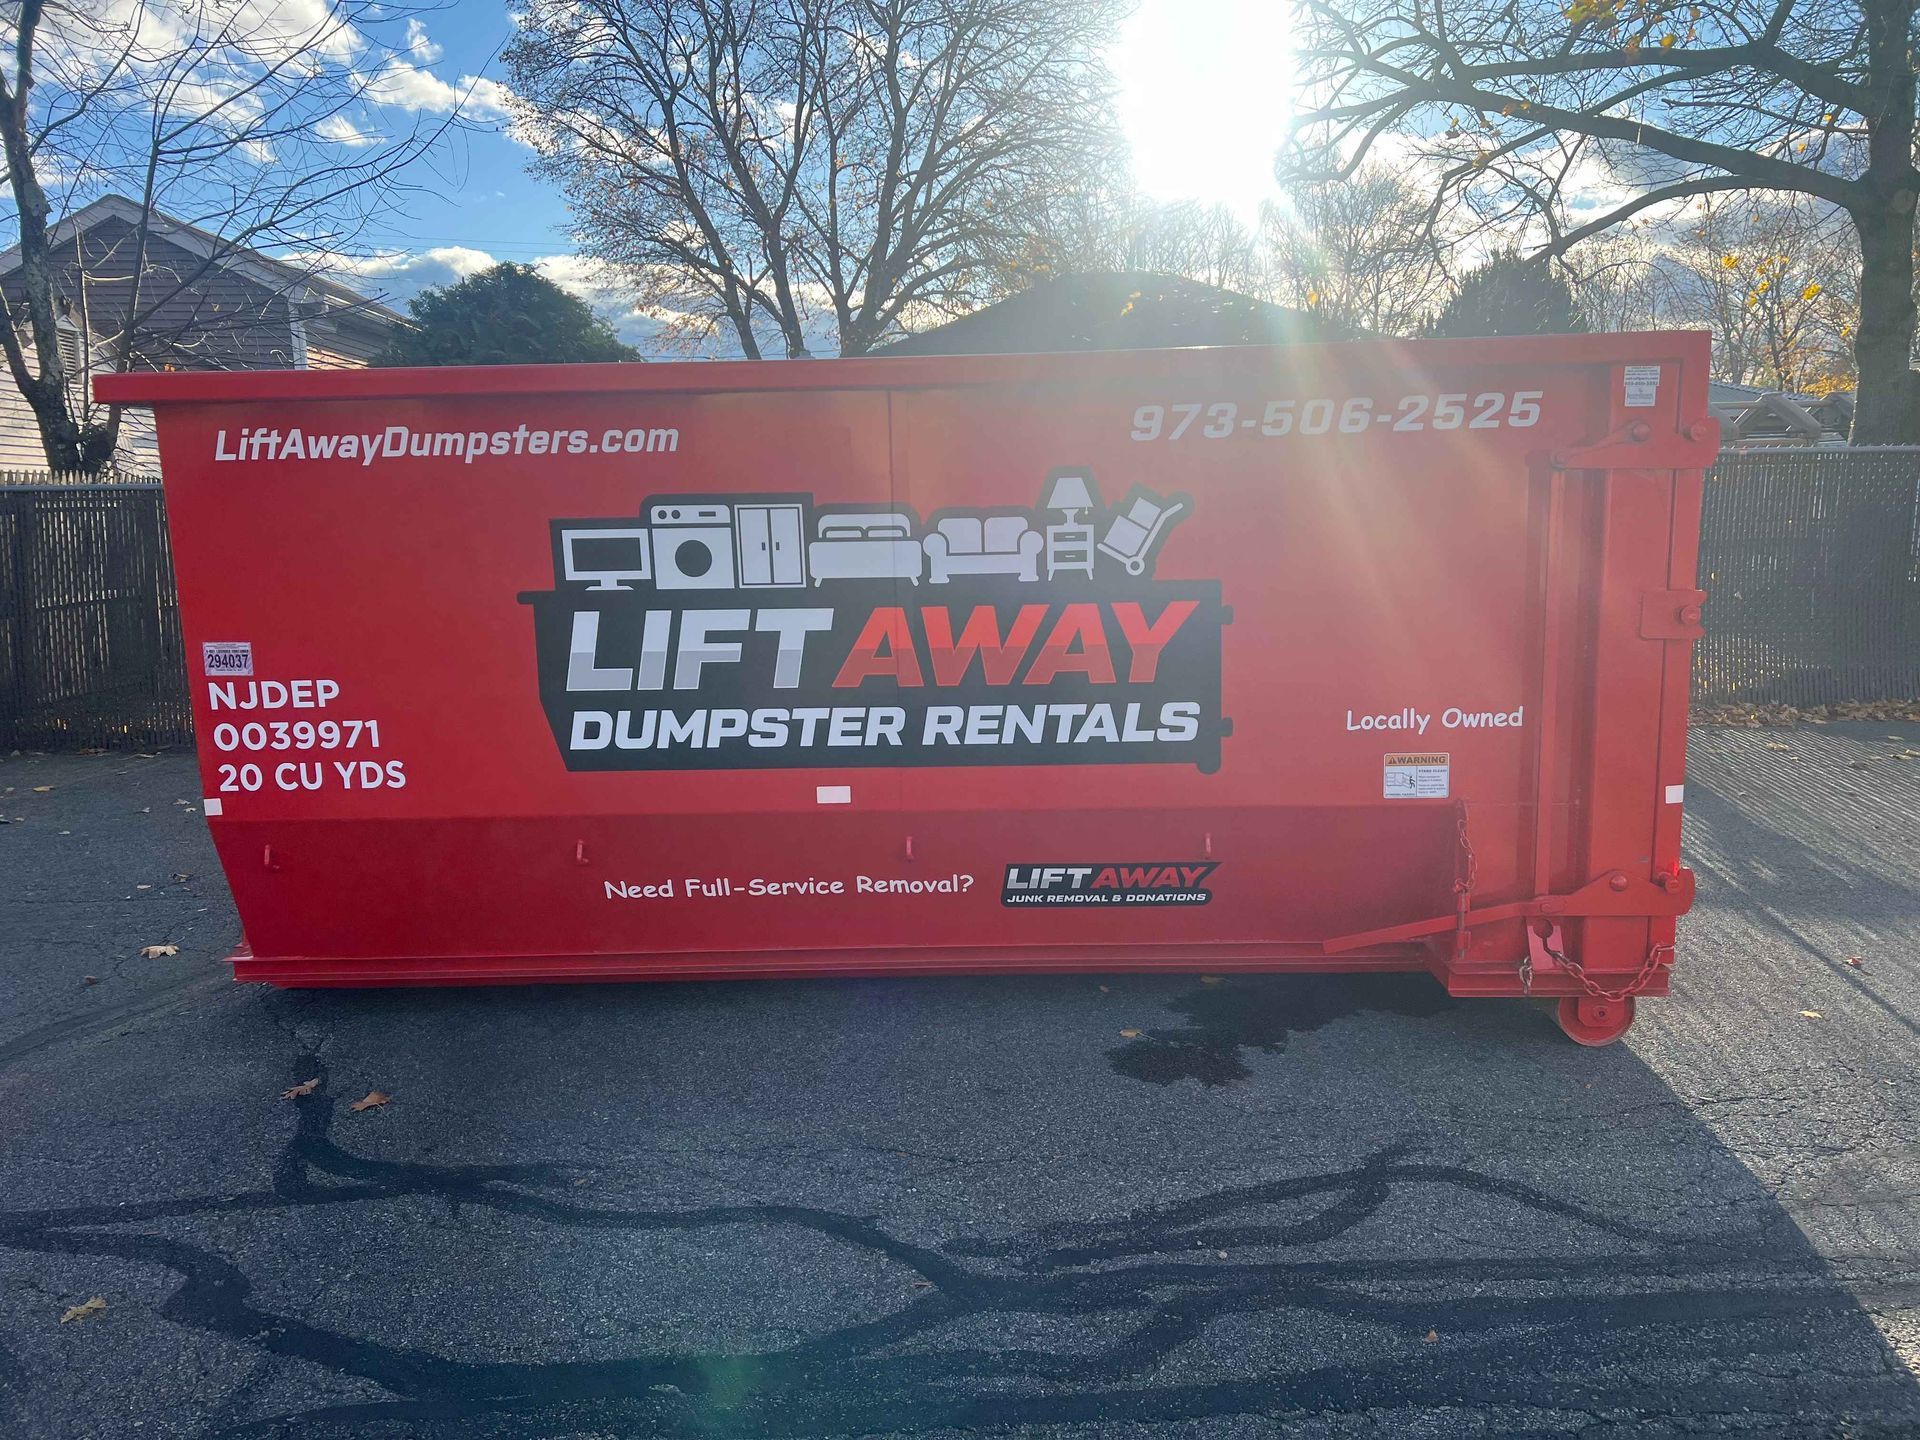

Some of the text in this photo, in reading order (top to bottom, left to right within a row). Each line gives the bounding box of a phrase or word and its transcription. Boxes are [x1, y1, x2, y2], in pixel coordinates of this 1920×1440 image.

[1130, 391, 1543, 441] 973-506-2525
[215, 424, 679, 466] LiftAwayDumpsters.com
[207, 654, 248, 668] 294037
[565, 600, 1200, 691] LIFT AWAY
[208, 679, 340, 710] NJDEP
[213, 719, 379, 751] 0039971
[569, 701, 1200, 750] DUMPSTER RENTALS
[1346, 705, 1524, 735] Locally Owned
[1397, 755, 1446, 764] WARNING
[218, 760, 406, 791] 20 CU YDS
[604, 874, 974, 899] Need Full-Service Removal?
[1007, 866, 1208, 889] LIFT AWAY
[1007, 893, 1206, 903] JUNK REMOVAL & DONATIONS
